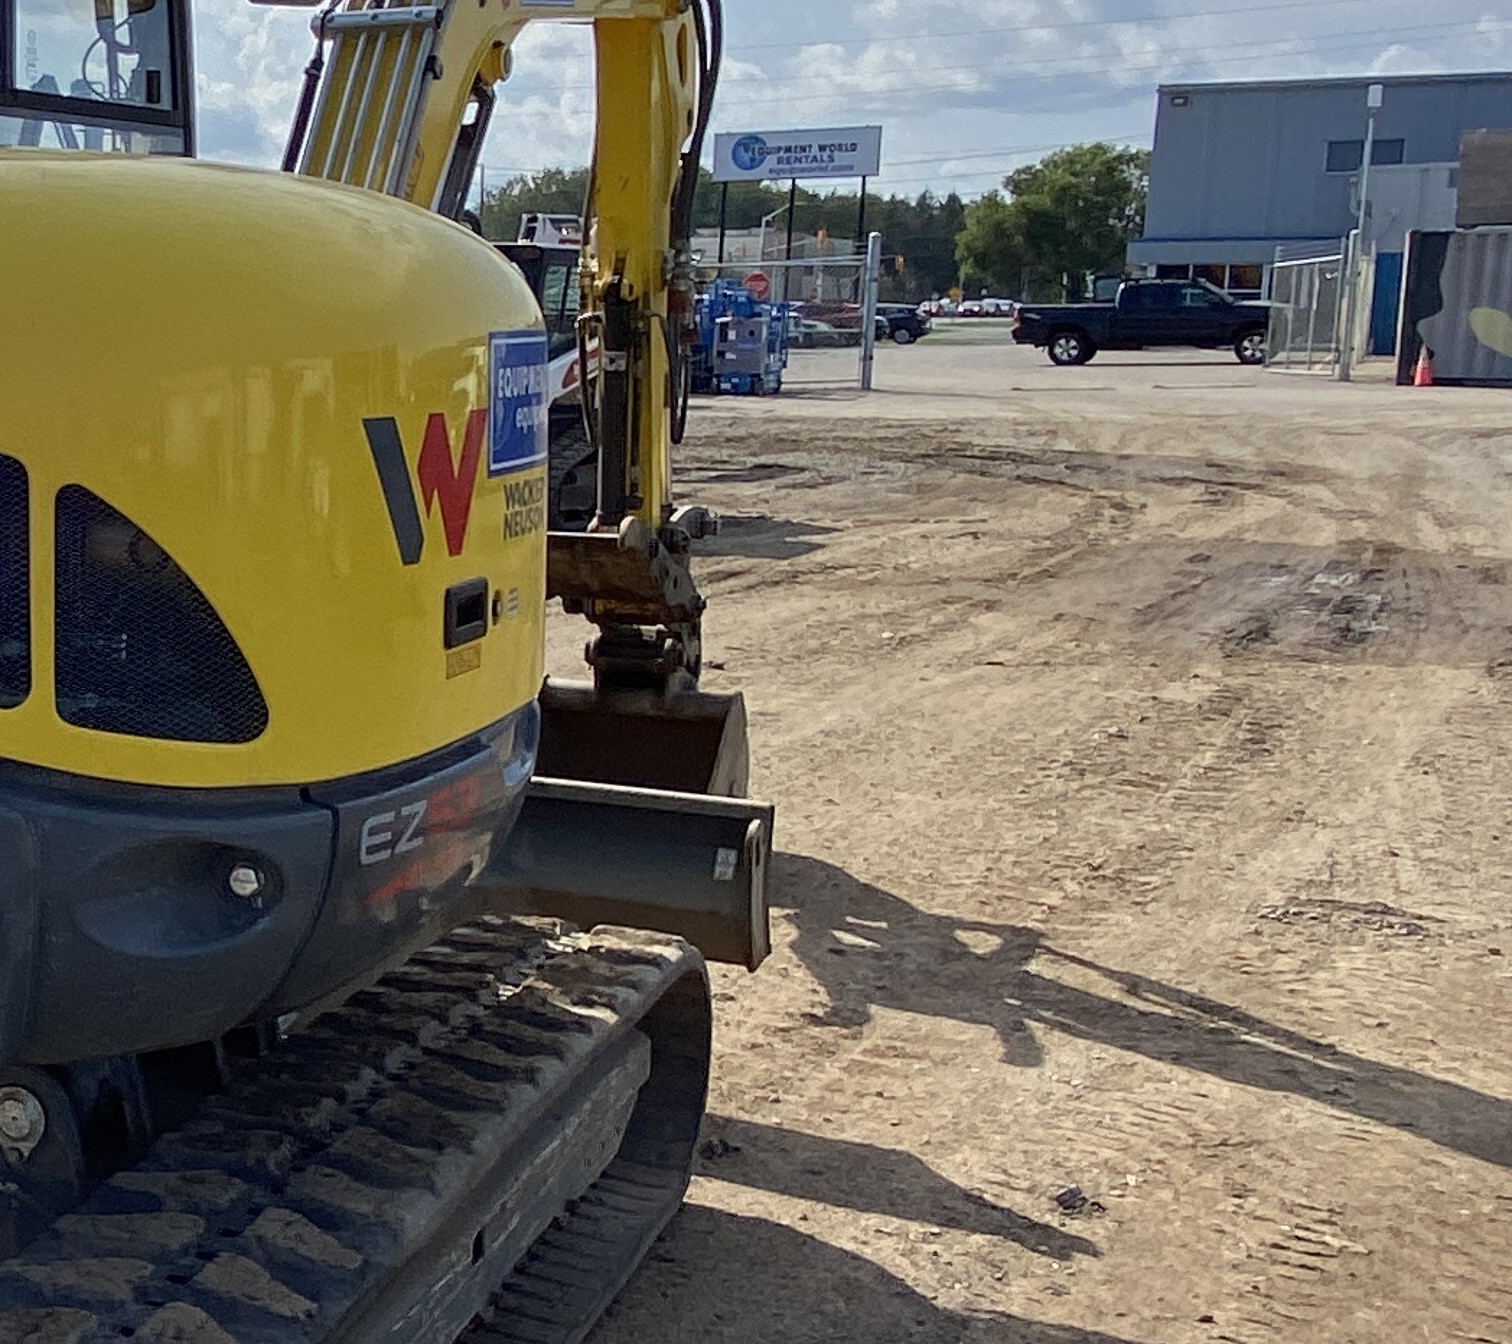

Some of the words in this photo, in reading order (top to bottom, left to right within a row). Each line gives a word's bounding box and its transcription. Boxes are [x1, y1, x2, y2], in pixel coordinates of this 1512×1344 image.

[751, 144, 813, 158] EQUIPMENT
[818, 142, 857, 153] WORLD
[776, 154, 835, 165] RENTALS
[362, 409, 488, 565] W
[504, 477, 545, 510] WACKER
